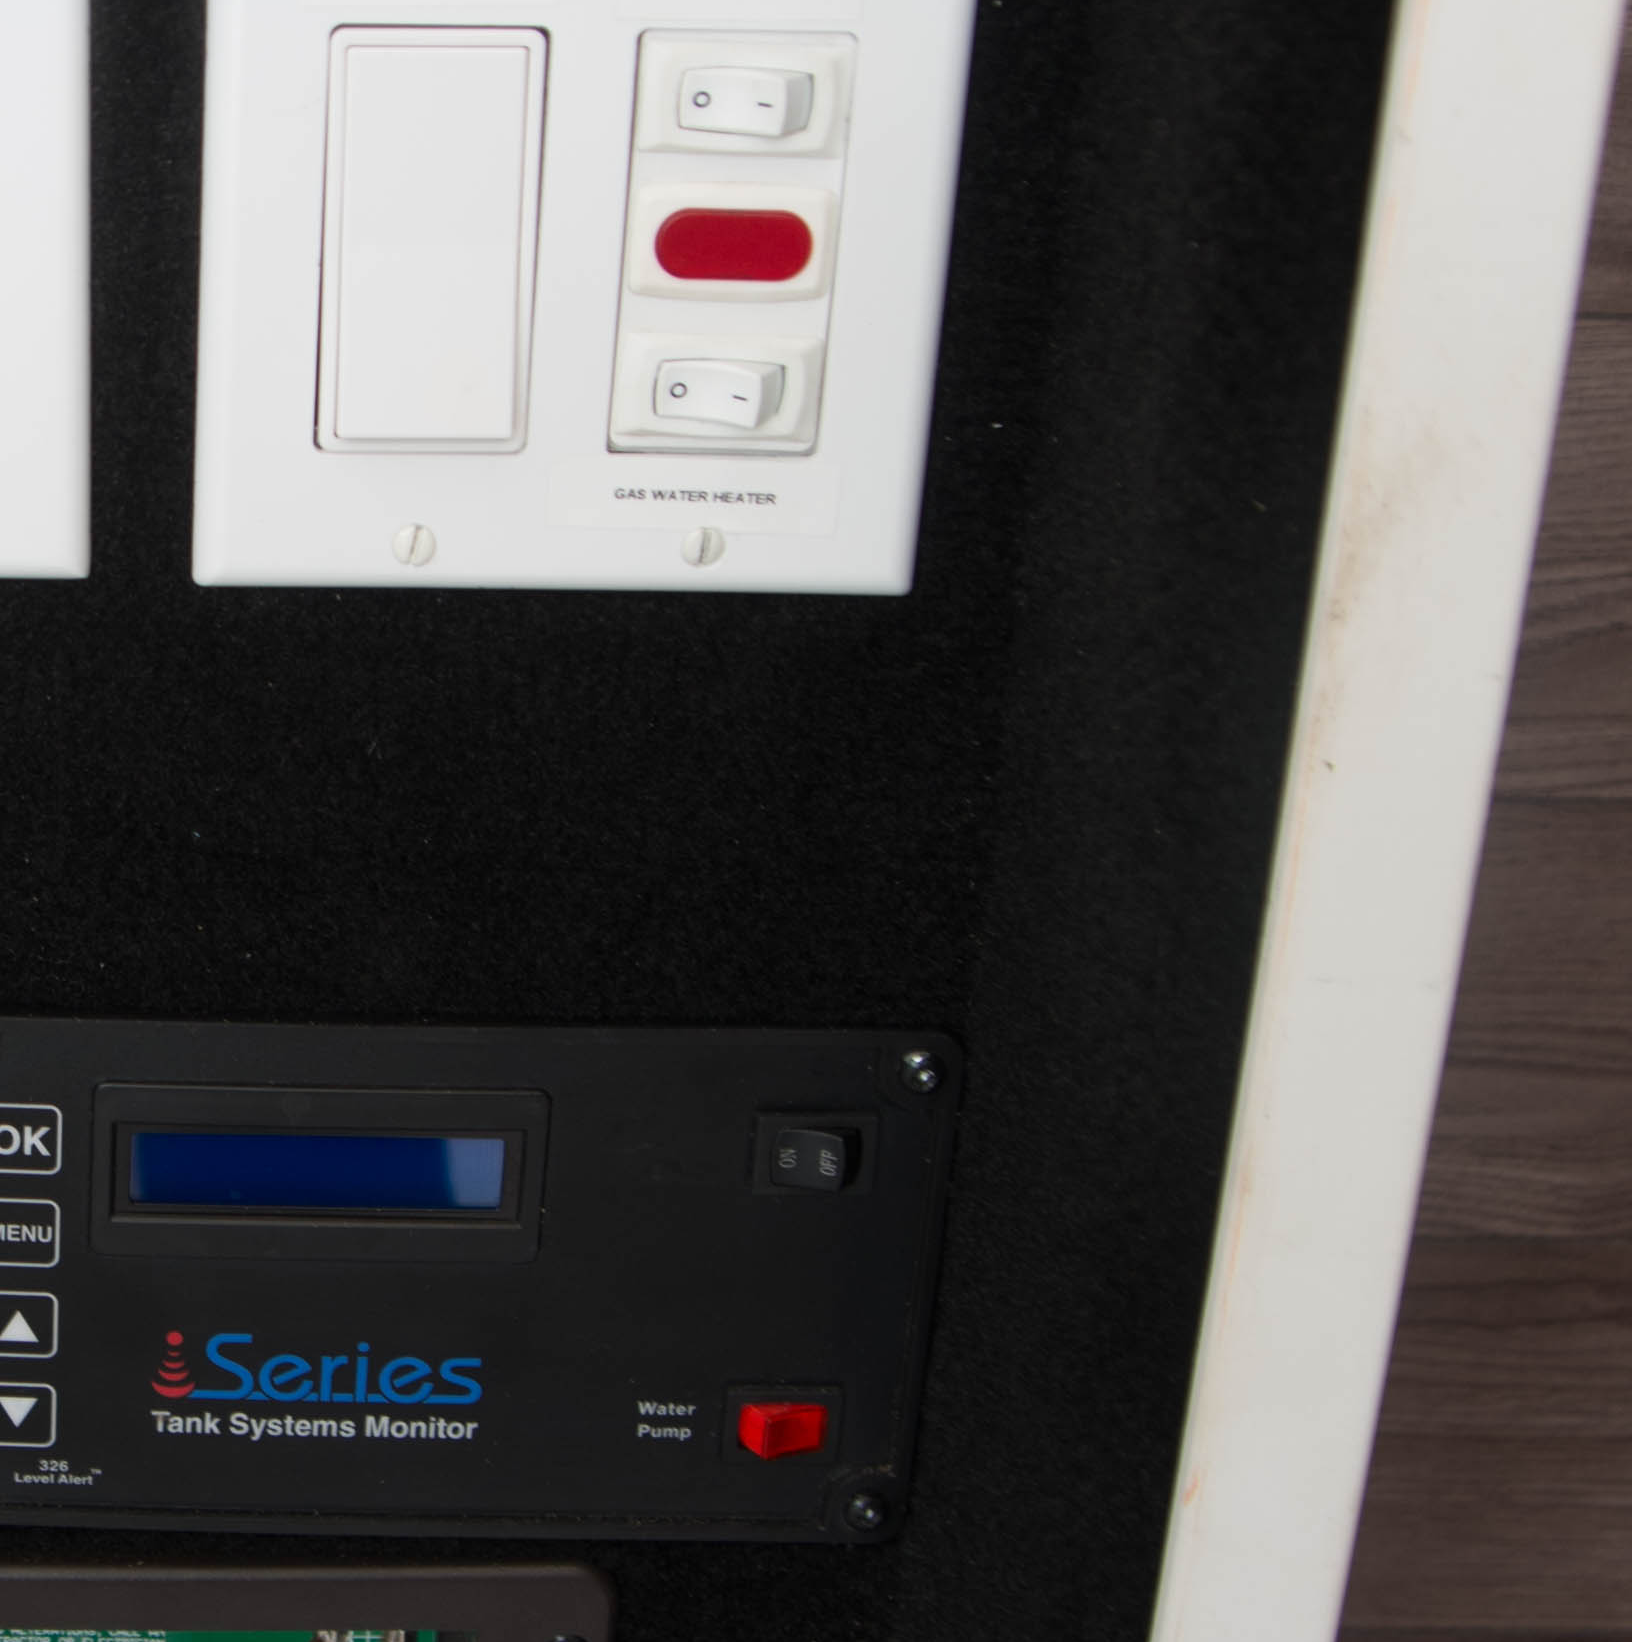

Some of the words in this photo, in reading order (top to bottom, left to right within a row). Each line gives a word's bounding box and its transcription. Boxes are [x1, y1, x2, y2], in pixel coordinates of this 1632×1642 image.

[614, 488, 647, 501] GAS
[652, 489, 709, 503] WATER
[712, 491, 778, 505] HEATER
[778, 1147, 798, 1169] ON
[819, 1149, 839, 1177] OFF
[636, 1400, 697, 1417] Water
[150, 1410, 222, 1436] Tank
[228, 1411, 358, 1441] Systems
[363, 1414, 479, 1440] Monitor
[636, 1423, 693, 1442] Pump
[39, 1459, 70, 1473] 326
[13, 1471, 55, 1485] Level
[57, 1473, 94, 1486] Alert
